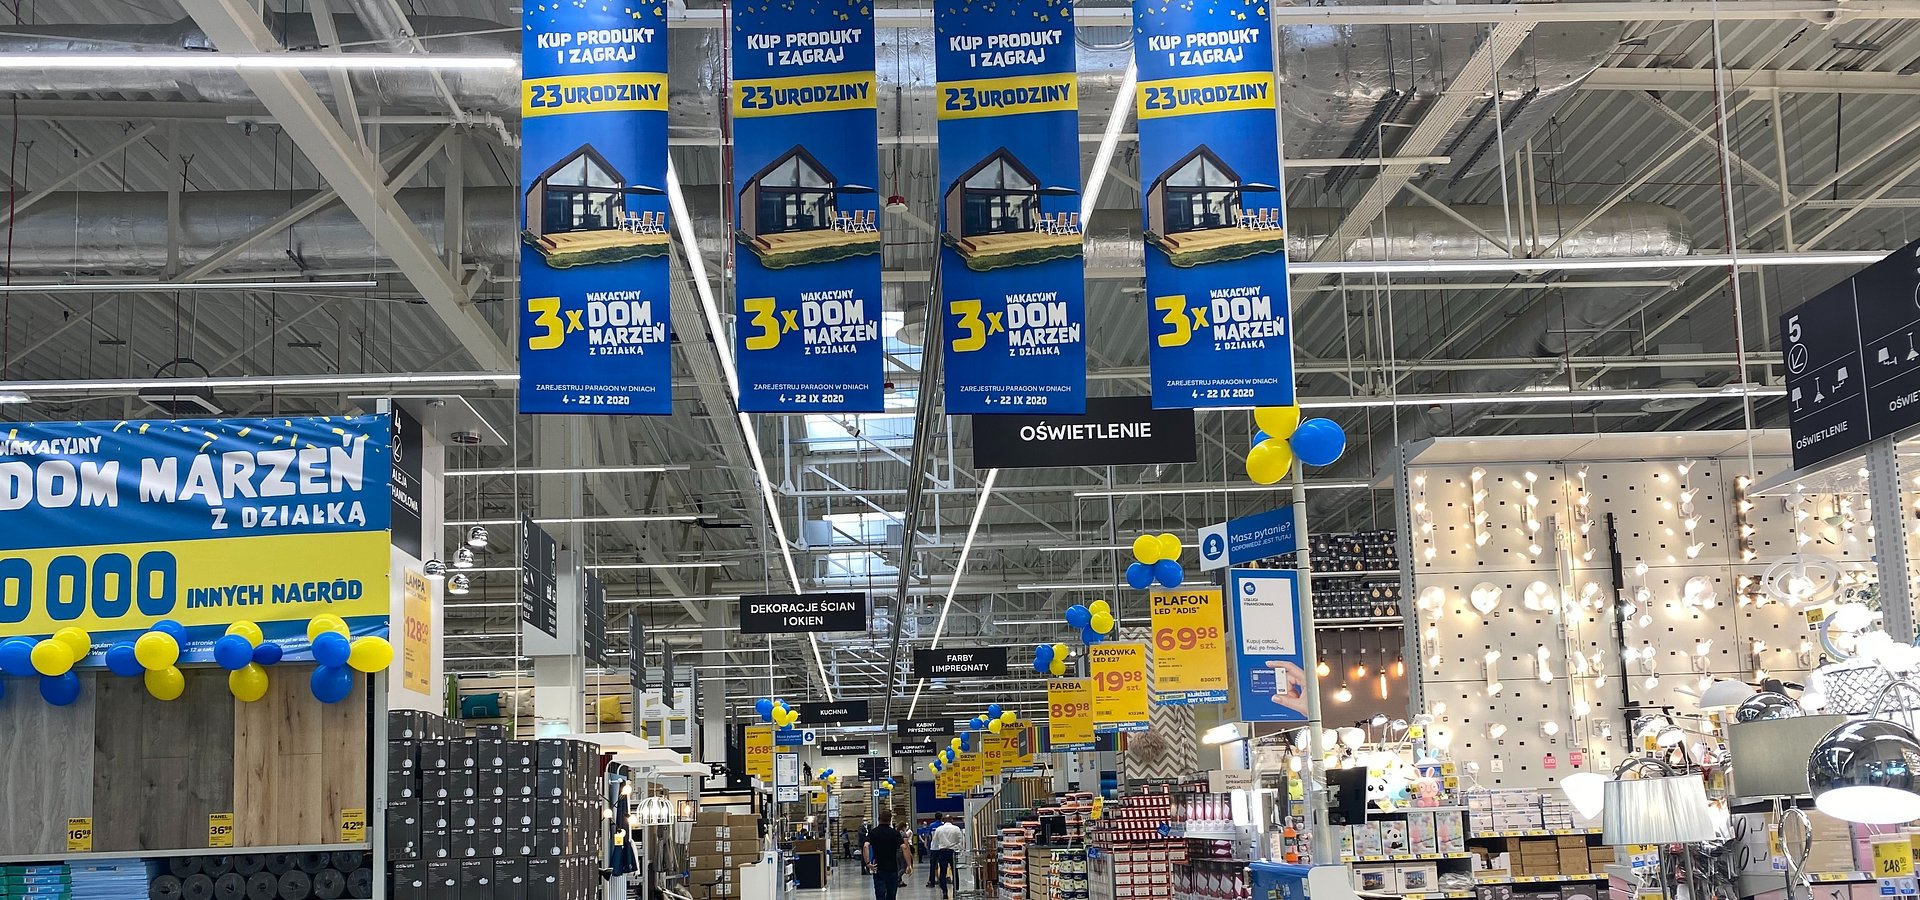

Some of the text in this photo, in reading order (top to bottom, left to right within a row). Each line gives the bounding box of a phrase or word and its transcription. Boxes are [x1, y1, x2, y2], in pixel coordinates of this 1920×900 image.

[538, 28, 655, 48] KUP PRODUKT
[748, 29, 861, 49] KUP PRODUKT
[950, 30, 1062, 51] KUP PRODUKT
[1149, 28, 1259, 51] KUP PRODUKT
[558, 46, 636, 64] I ZAGRAJ
[768, 47, 844, 66] I ZAGRAJ
[970, 48, 1046, 67] I ZAGRAJ
[1169, 46, 1243, 67] I ZAGRAJ
[587, 290, 640, 301] WAKACYJNY
[801, 289, 853, 301] WAKACYJNY
[1006, 292, 1057, 303] WAKACYJNY
[1210, 286, 1261, 298] WAKACYJNY
[587, 301, 652, 327] DOM
[802, 300, 864, 327] DOM
[1007, 302, 1068, 328] DOM
[1212, 296, 1272, 323] DOM
[589, 322, 665, 346] MARZEŃ
[804, 320, 878, 345] MARZEŃ
[1009, 322, 1080, 347] MARZEŃ
[1214, 315, 1284, 341] MARZEŃ
[1788, 315, 1801, 342] 5
[589, 346, 644, 355] Z DZIAŁKĄ
[805, 345, 857, 355] Z DZIAŁKĄ
[1009, 345, 1060, 356] Z DZIAŁKĄ
[1215, 340, 1265, 351] Z DZIAŁKĄ
[563, 395, 630, 405] 4 22 IX 2020
[779, 394, 844, 403] 4 22 IX 2020
[985, 395, 1047, 405] 4 22 IX 2020
[1192, 389, 1254, 399] 4 22 IX 2020
[1890, 390, 1920, 411] OŚWIE
[394, 409, 401, 434] 4
[1020, 421, 1152, 442] OŚWIETLENIE
[1796, 420, 1848, 450] OŚWIETLENIE
[0, 433, 366, 510] DOM MARZEŃ
[392, 468, 408, 489] ALEJA
[391, 484, 419, 513] HANDLOWA
[211, 501, 366, 531] Z DZIAŁKĄ
[1231, 521, 1291, 544] Masz pytanie?
[1262, 537, 1274, 545] JEST
[1275, 534, 1291, 542] TUTAJ
[46, 550, 178, 621] 000
[187, 584, 263, 609] INNYCH
[272, 578, 363, 604] NAGRÓD
[406, 573, 425, 593] LAMPA
[751, 601, 855, 614] DEKORACJE ŚCIAN
[1154, 595, 1209, 607] PLAFON
[784, 616, 823, 626] I OKIEN
[947, 654, 974, 663] FARBY
[1093, 648, 1136, 656] ŻARÓWKA
[932, 663, 989, 673] I IMPREGNATY
[820, 708, 848, 716] KUCHNIA
